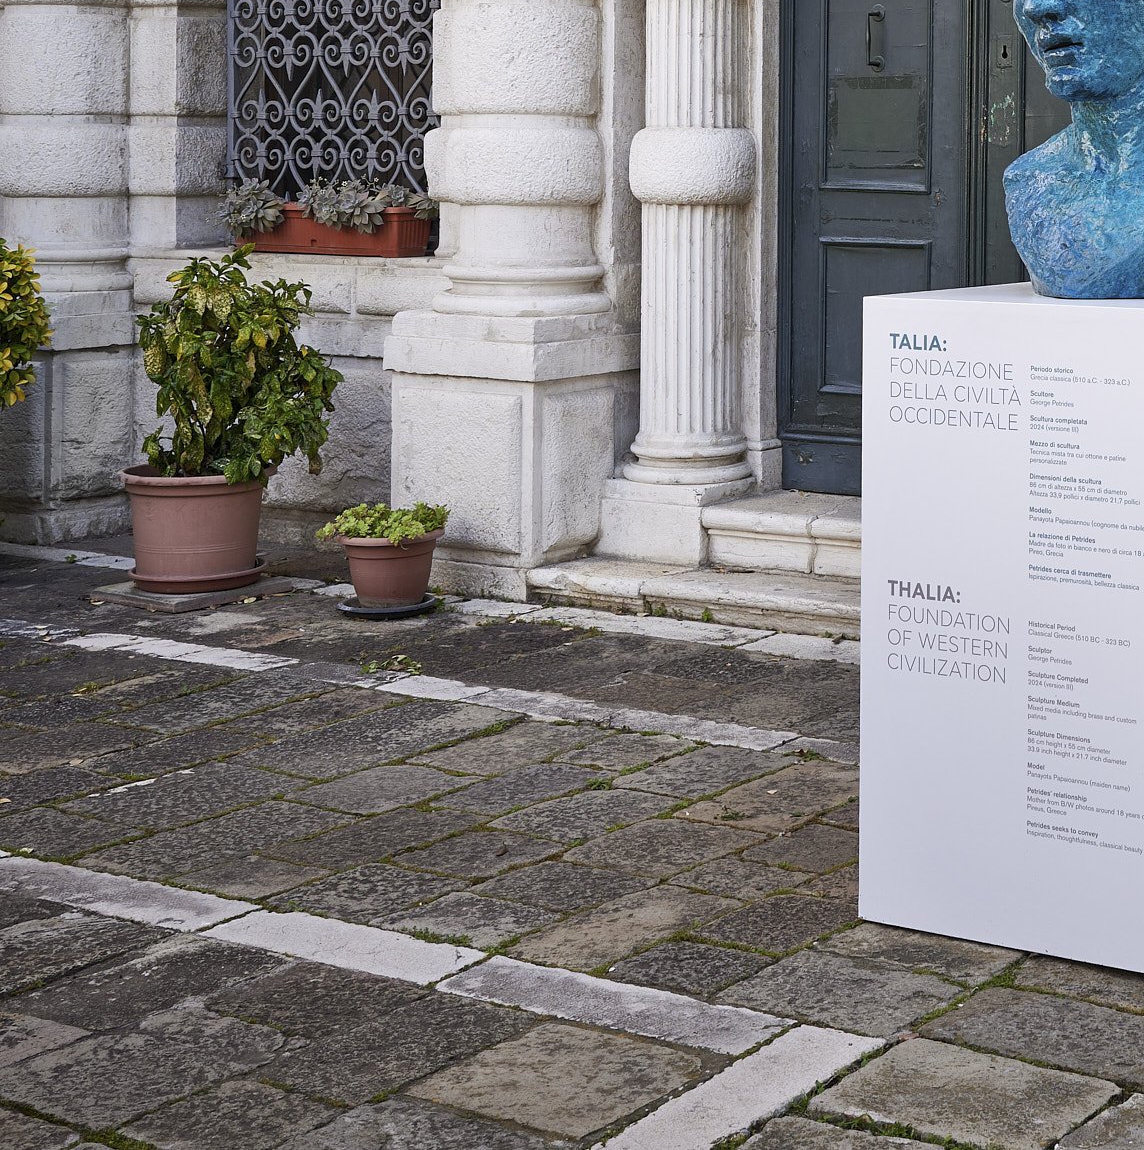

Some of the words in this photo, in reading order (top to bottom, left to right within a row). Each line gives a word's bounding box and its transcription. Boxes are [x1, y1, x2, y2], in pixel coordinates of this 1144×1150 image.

[889, 333, 947, 352] TALIA:
[890, 357, 1014, 380] FONDAZIONE
[1030, 365, 1053, 373] Periodo
[890, 381, 948, 401] DELLA
[954, 385, 1021, 406] CIVILTÀ
[1029, 398, 1051, 407] George
[889, 406, 1019, 431] OCCIDENTALE
[1055, 418, 1088, 426] completata
[1045, 424, 1070, 432] (versione
[1029, 448, 1050, 456] Tecnica
[1029, 457, 1067, 465] personalizzate
[1029, 473, 1062, 481] Dimensioni
[1063, 493, 1080, 501] pollici
[1084, 495, 1109, 503] diametro
[1103, 488, 1128, 496] diametro
[1029, 506, 1052, 514] Modello
[1029, 514, 1054, 523] Panayota
[1055, 517, 1090, 526] Papaioannou
[1091, 520, 1119, 529] (cognome
[1029, 539, 1046, 547] Madre
[1073, 544, 1093, 552] bianco
[1072, 535, 1096, 543] Petrides
[1045, 549, 1064, 557] Grecia
[1028, 564, 1053, 573] Petrides
[1078, 570, 1112, 579] trasmettere
[888, 580, 961, 603] THALIA:
[1094, 580, 1116, 588] bellezza
[1117, 582, 1140, 590] classica
[888, 604, 1010, 634] FOUNDATION
[1028, 621, 1056, 629] Historical
[1057, 623, 1076, 632] Period
[887, 629, 912, 646] OF
[918, 632, 1008, 659] WESTERN
[1028, 629, 1053, 637] Classical
[1053, 632, 1074, 640] Greece
[1118, 639, 1130, 648] BC)
[1028, 645, 1052, 654] Sculptor
[1028, 654, 1049, 663] George
[1050, 656, 1073, 665] Petrides
[888, 653, 1006, 684] CIVILIZATION
[1028, 670, 1056, 681] Sculpture
[1057, 674, 1089, 685] Completed
[1043, 680, 1065, 689] (version
[1028, 695, 1055, 705] Sculpture
[1056, 699, 1080, 708] Medium
[1027, 703, 1044, 712] Mixed
[1062, 709, 1087, 719] including
[1088, 712, 1103, 720] brass
[1027, 713, 1047, 721] patinas
[1028, 729, 1055, 738] Sculpture
[1057, 733, 1091, 743] Dimensions
[1046, 739, 1063, 749] height
[1087, 746, 1111, 754] diameter
[1054, 749, 1071, 758] height
[1103, 757, 1127, 765] diameter
[1027, 762, 1045, 770] Model
[1027, 770, 1052, 780] Panayota
[1089, 779, 1112, 789] (maiden
[1113, 785, 1131, 793] name)
[1027, 795, 1046, 804] Mother
[1047, 798, 1060, 806] from
[1075, 802, 1095, 812] photos
[1053, 792, 1087, 803] relationship
[1046, 807, 1067, 815] Greece
[1027, 820, 1050, 830] Petrides
[1078, 830, 1099, 839] convey
[1099, 841, 1123, 850] classical
[1124, 845, 1143, 855] beauty
